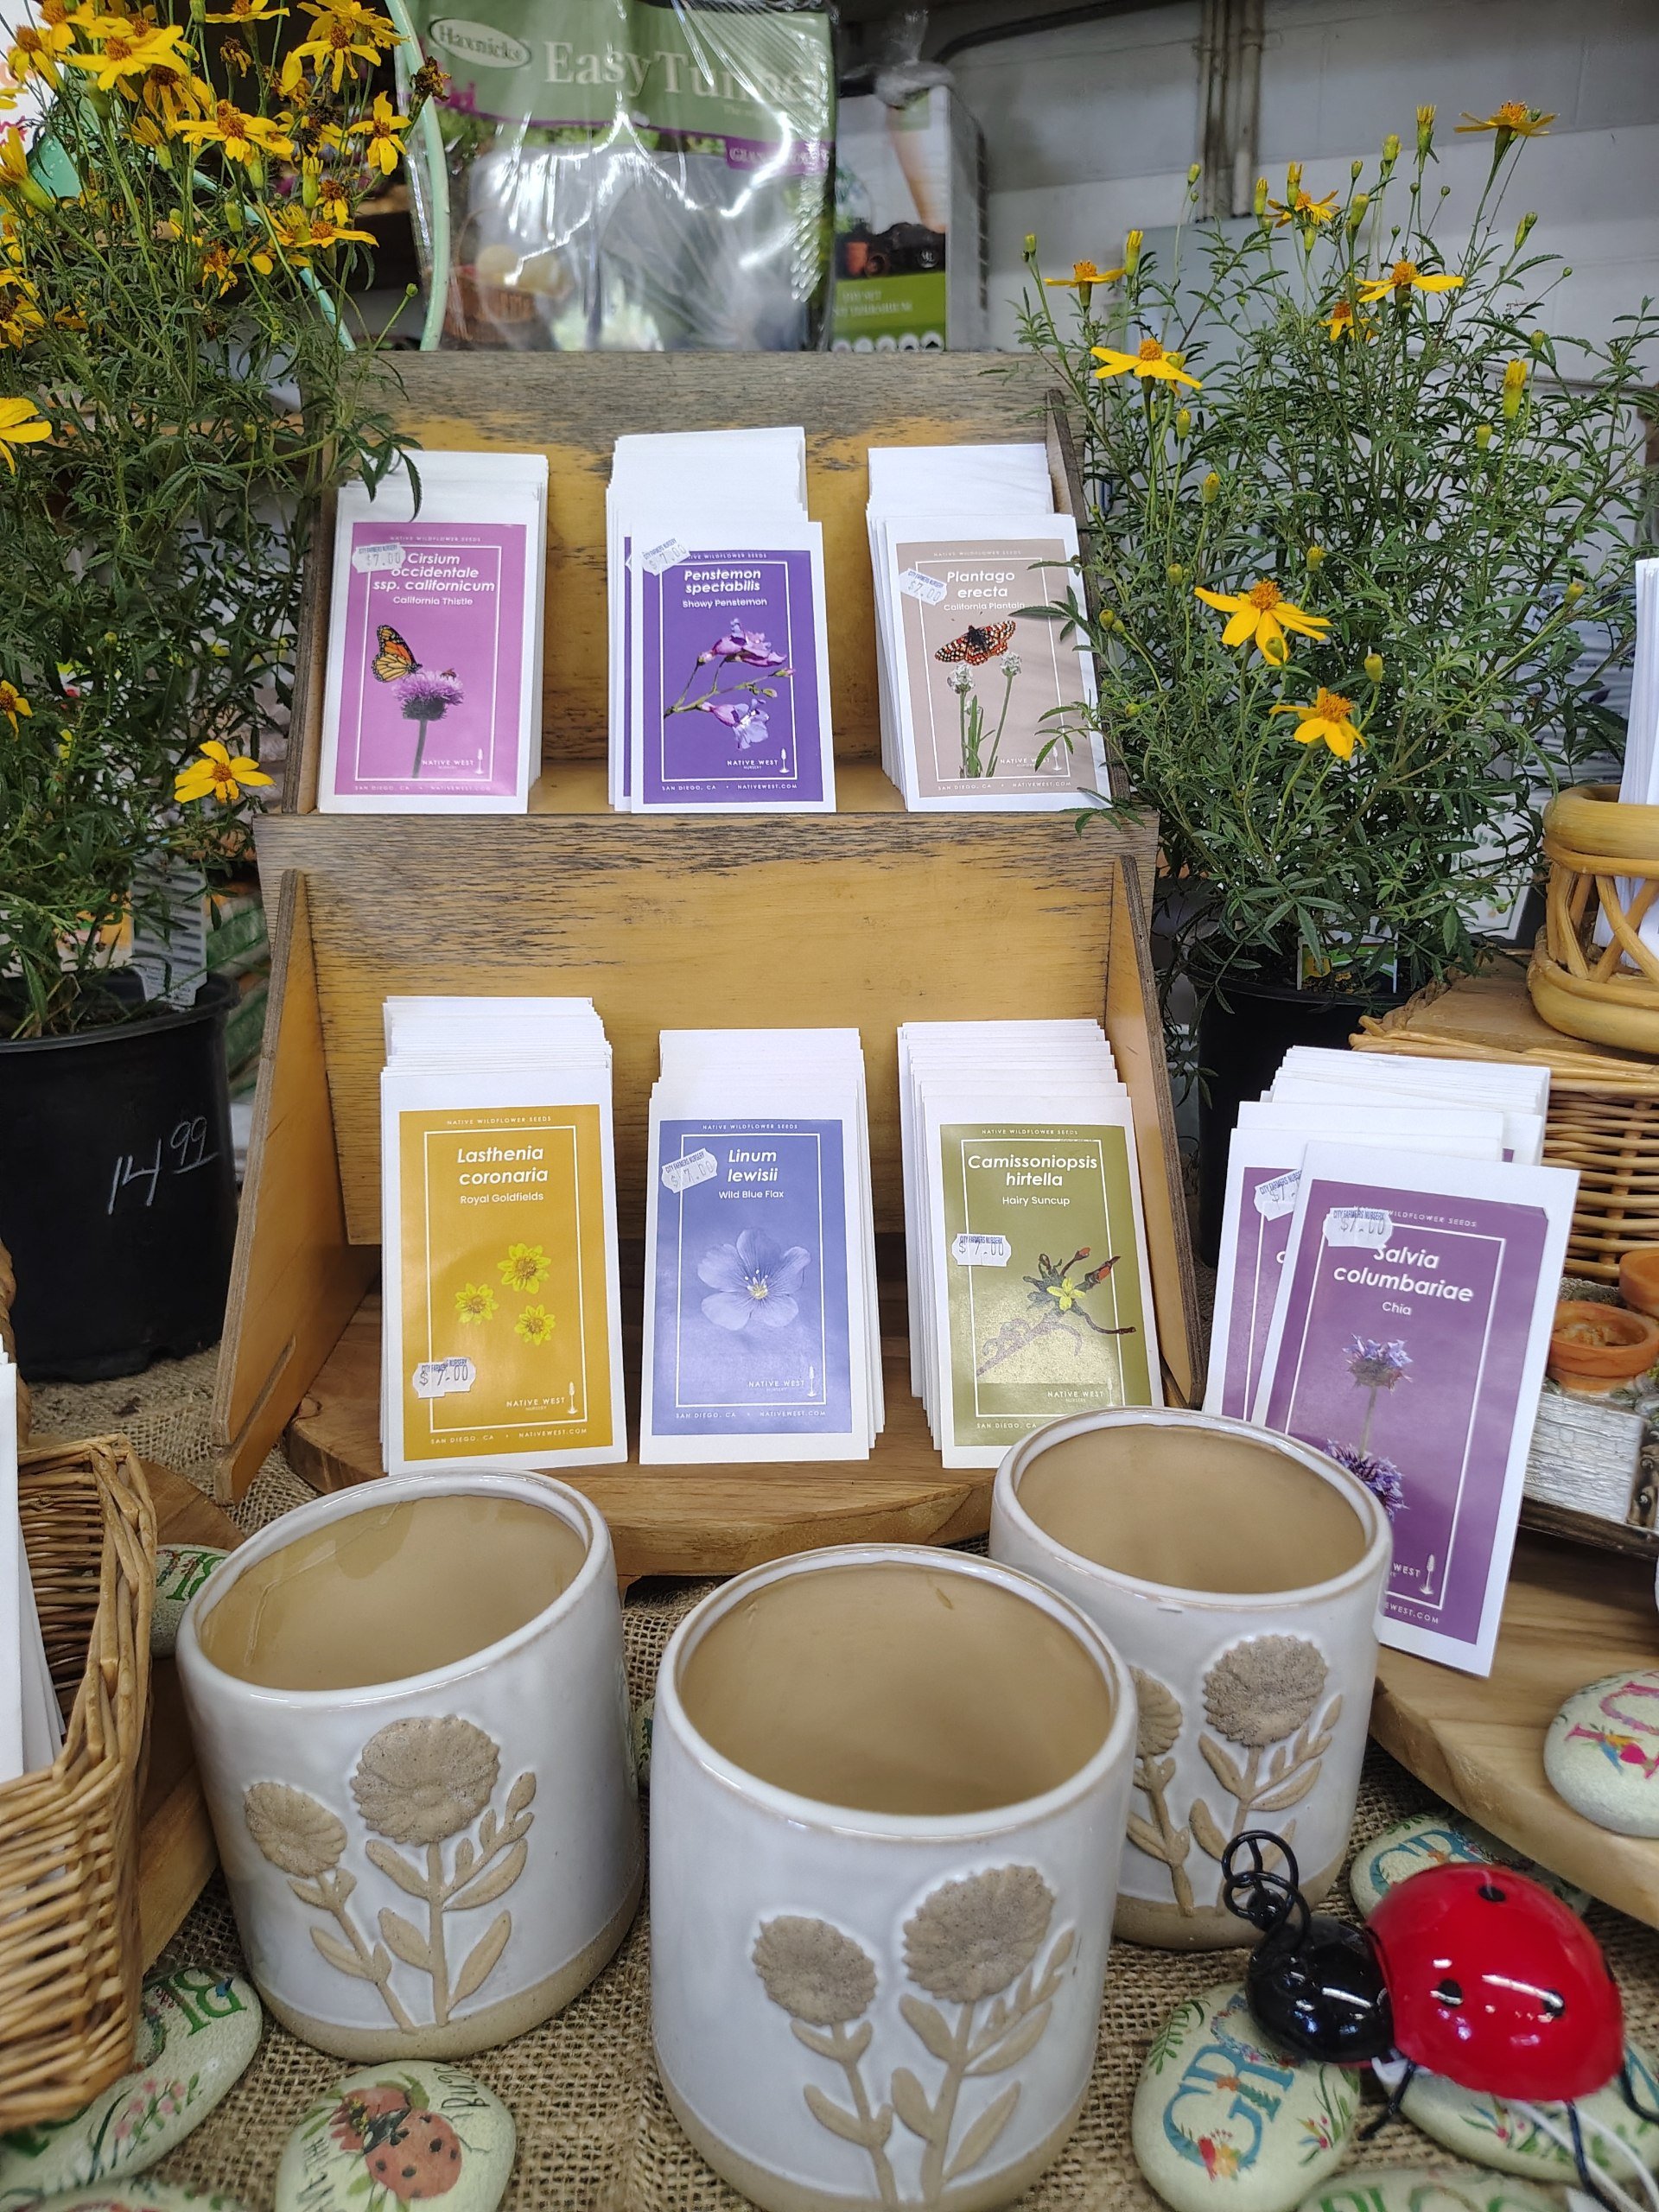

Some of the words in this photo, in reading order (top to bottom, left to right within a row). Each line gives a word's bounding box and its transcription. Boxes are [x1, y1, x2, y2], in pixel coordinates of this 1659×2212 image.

[408, 553, 460, 564] Cirsium
[391, 567, 479, 578] occidentale
[684, 568, 761, 582] Penstemon
[947, 570, 1015, 583] Plantago
[373, 581, 400, 592] ssp.
[405, 580, 495, 592] californicum
[685, 581, 760, 595] spectabilis
[957, 587, 1008, 598] erecta
[393, 596, 441, 606] California
[442, 597, 473, 606] Thistle
[683, 601, 713, 609] Showy
[715, 598, 767, 607] Penstemon
[989, 601, 1026, 610] Plantain
[457, 1145, 543, 1163] Lasthenia
[728, 1148, 777, 1163] Linum
[968, 1154, 1097, 1172] Camissoniopsis
[459, 1166, 549, 1185] coronaria
[728, 1167, 779, 1182] lewisii
[1006, 1173, 1063, 1186] hirtella
[460, 1194, 489, 1205] Royal
[492, 1192, 544, 1203] Goldfields
[719, 1191, 740, 1199] Wild
[742, 1190, 763, 1198] Blue
[766, 1190, 784, 1198] Flax
[1002, 1197, 1029, 1207] Hairy
[1032, 1196, 1071, 1207] Suncup
[1388, 1210, 1445, 1223] WILDFLOWER
[1447, 1218, 1477, 1227] SEEDS
[1374, 1244, 1440, 1269] Salvia
[1333, 1267, 1474, 1302] columbariae
[1382, 1301, 1412, 1315] Chia
[506, 1399, 538, 1408] NATIVE
[519, 1428, 588, 1438] NATIVEWEST.COM
[1393, 1562, 1421, 1578] WEST
